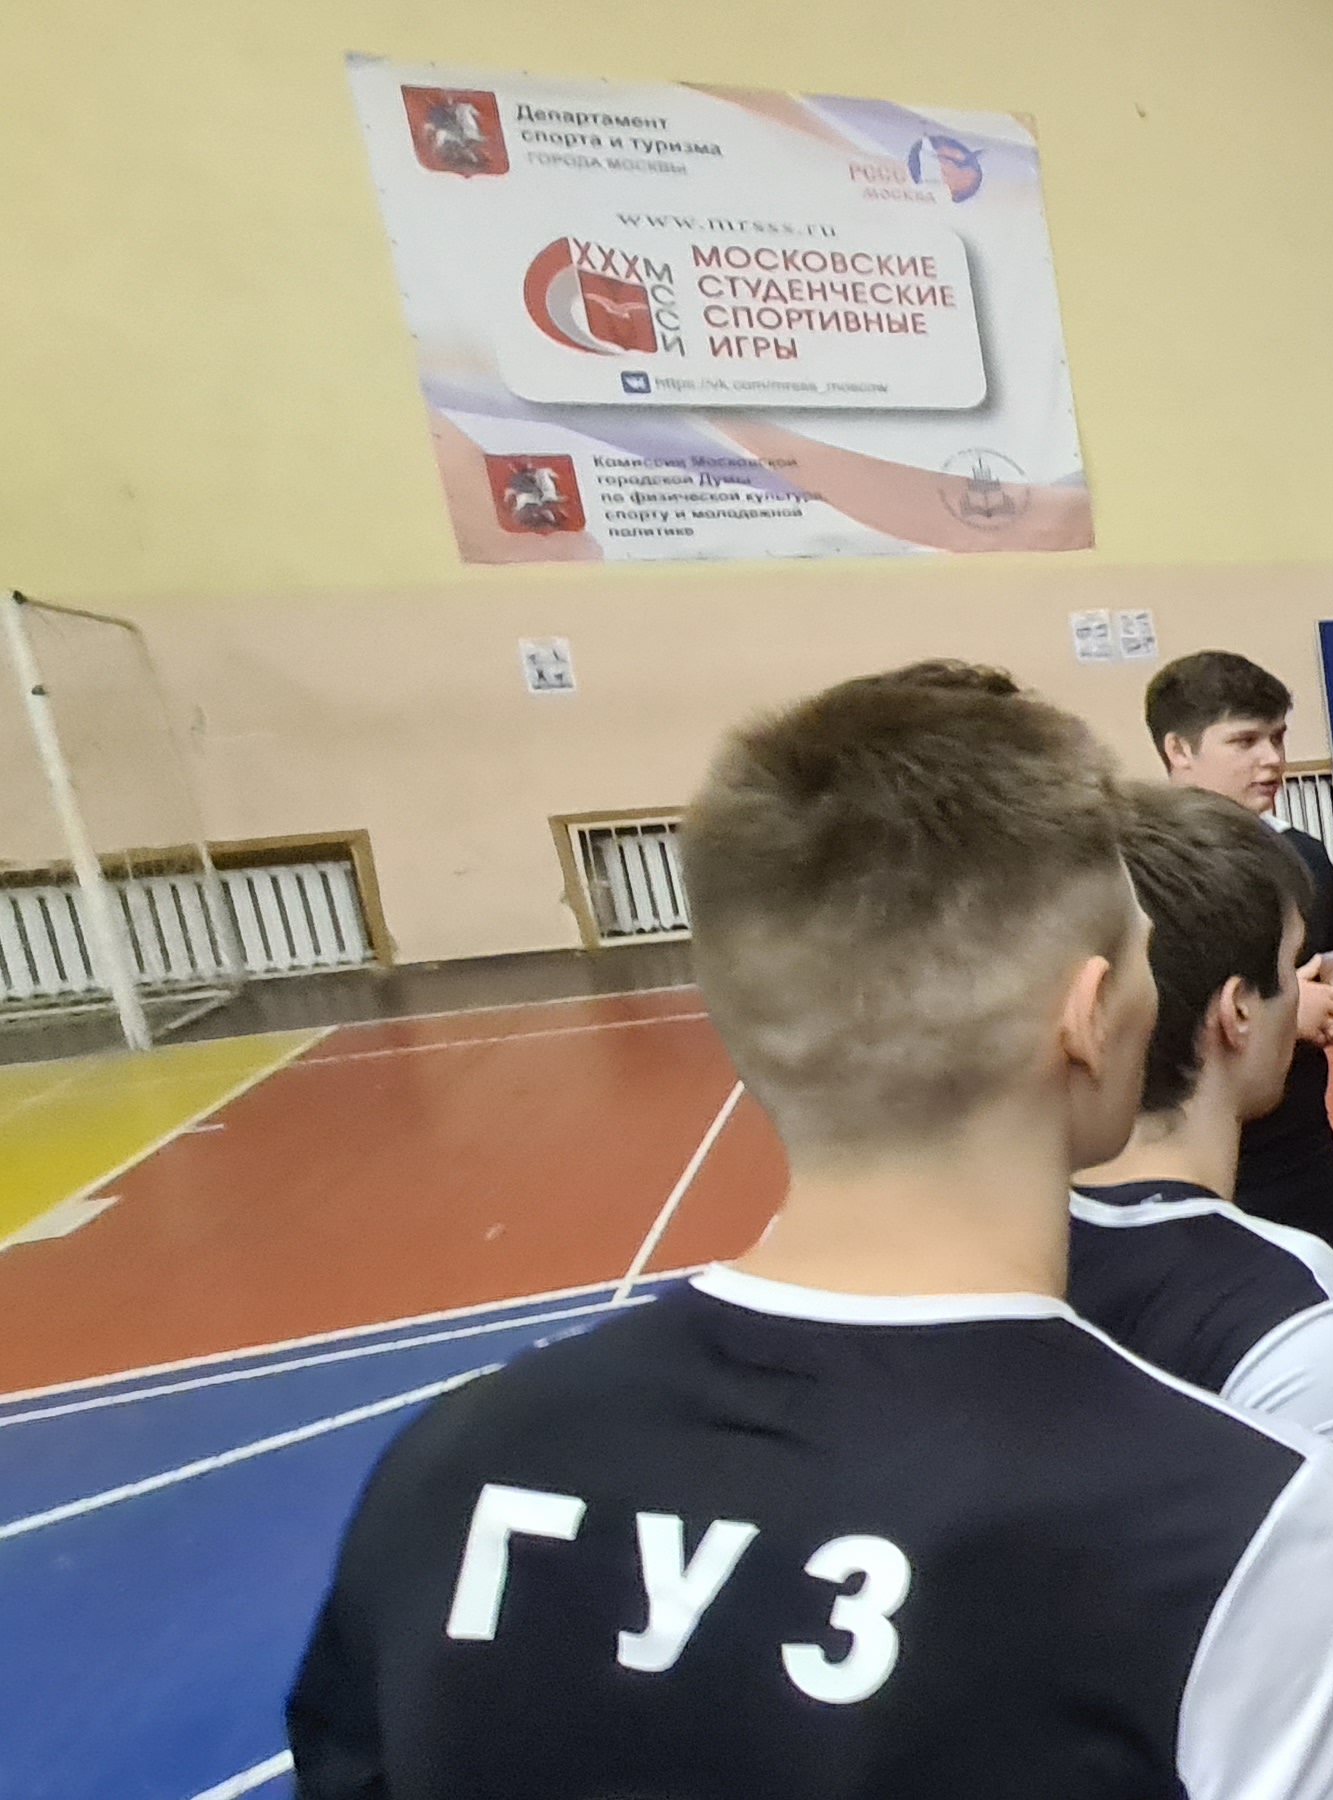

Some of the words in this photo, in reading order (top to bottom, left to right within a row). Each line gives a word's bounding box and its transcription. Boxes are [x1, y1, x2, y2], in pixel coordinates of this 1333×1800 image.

[516, 103, 668, 130] Департамент
[521, 129, 602, 148] спорта
[609, 137, 624, 149] и
[630, 137, 723, 156] туризма
[527, 151, 602, 169] ГОРОДА
[605, 157, 688, 175] МОСКВЫ
[615, 211, 838, 238] www.mrsss.ru
[690, 244, 938, 279] МОСКОВСКИЕ
[696, 274, 957, 308] СТУДЕНЧЕСКИЕ
[703, 304, 928, 335] СПОРТИВНЫЕ
[708, 336, 800, 360] ИГРЫ
[598, 474, 694, 488] городской
[601, 492, 625, 503] по
[630, 490, 741, 506] физической
[605, 510, 669, 523] спорту
[446, 1483, 913, 1705] ГУЗ
